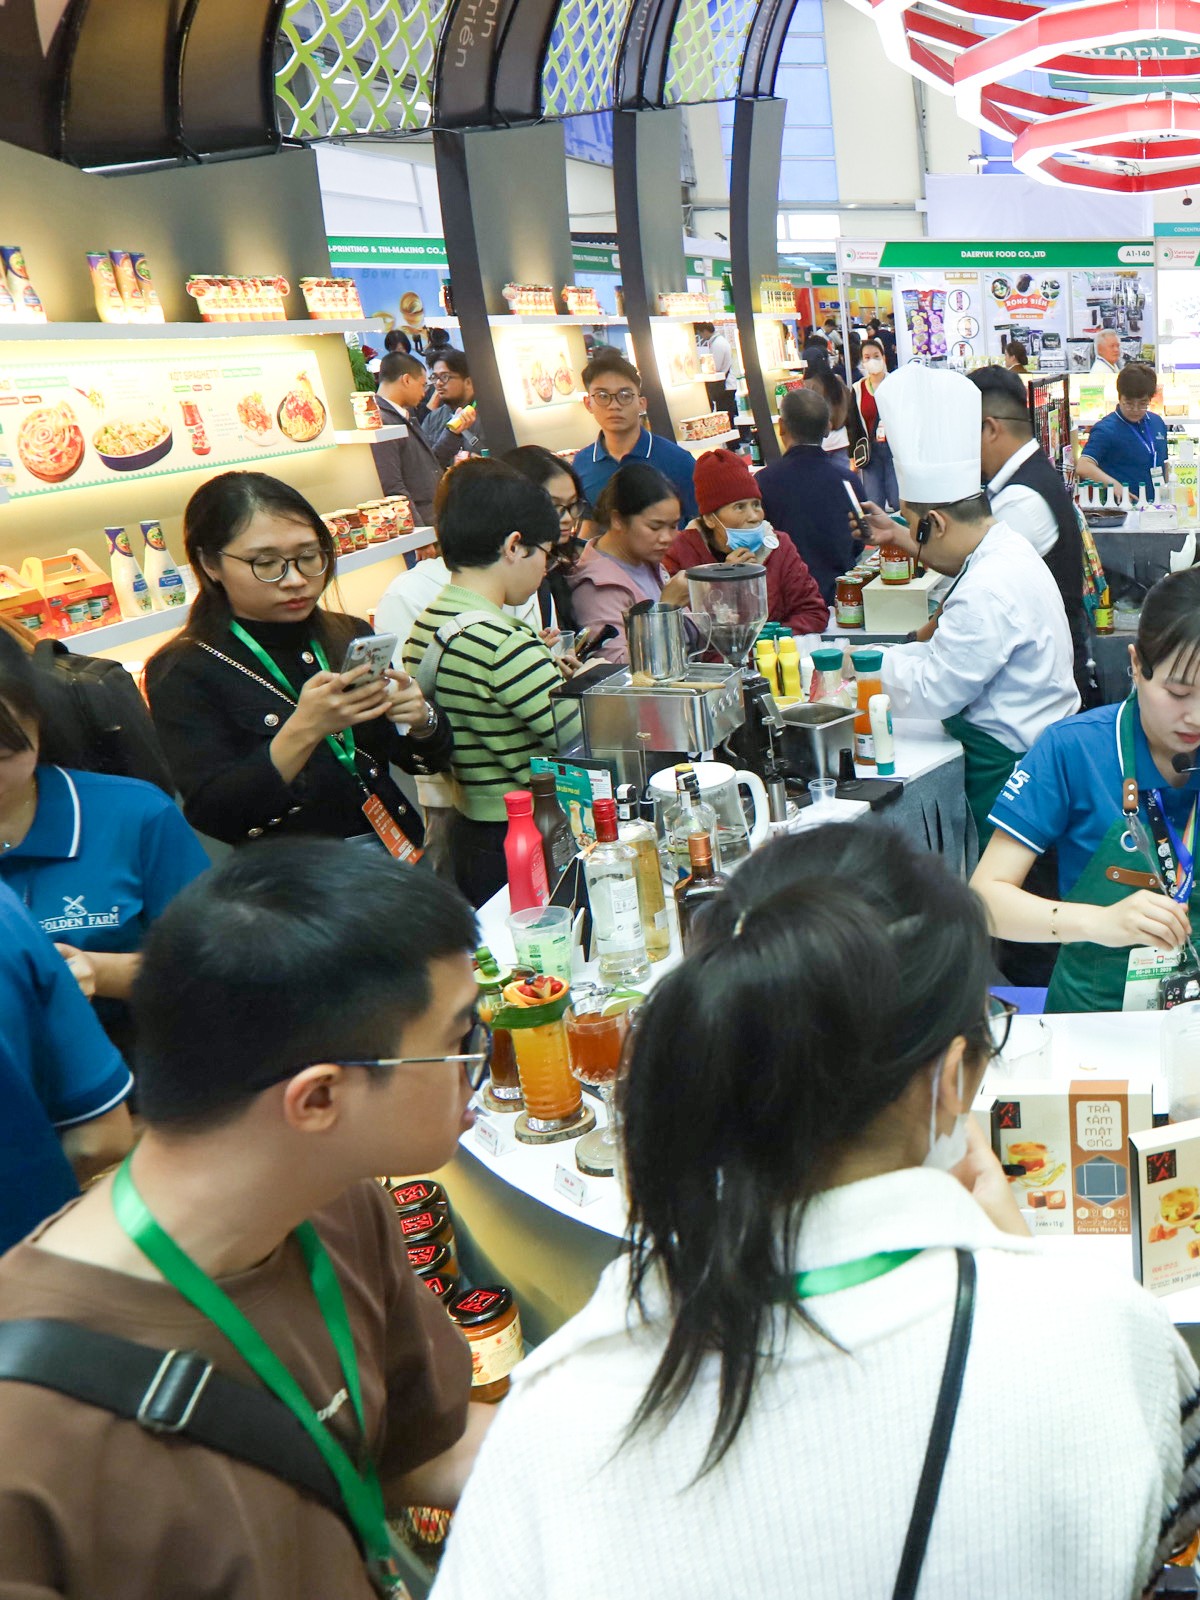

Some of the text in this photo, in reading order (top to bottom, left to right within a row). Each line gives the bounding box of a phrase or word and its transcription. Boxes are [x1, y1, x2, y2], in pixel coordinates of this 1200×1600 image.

[377, 246, 424, 255] TIN-MAKING
[961, 250, 1046, 259] DAERYUK FOOD CO.,LTD
[361, 268, 429, 280] Bowl Can
[1006, 297, 1029, 307] RONG
[88, 912, 120, 926] FARM
[1087, 1103, 1111, 1114] TRÀ
[1086, 1138, 1113, 1148] ONG
